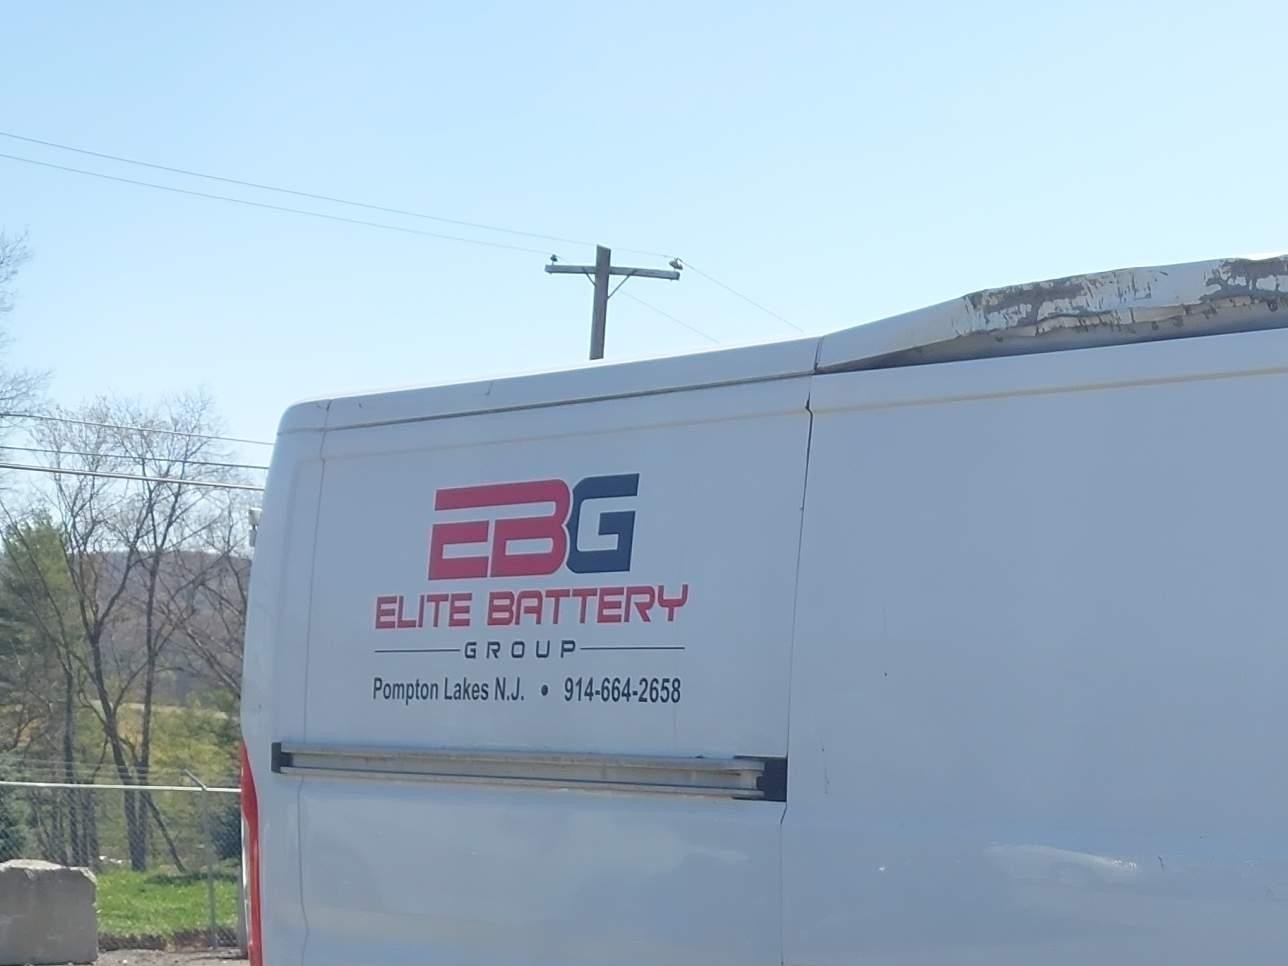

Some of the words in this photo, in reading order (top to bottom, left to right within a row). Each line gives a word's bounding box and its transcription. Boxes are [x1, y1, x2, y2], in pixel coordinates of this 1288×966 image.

[428, 473, 640, 580] EBG
[374, 592, 473, 629] ELITE
[487, 583, 689, 626] BATTERY
[464, 640, 576, 658] GROUP
[373, 677, 439, 705] Pompton
[444, 678, 489, 701] Lakes
[494, 677, 525, 701] N.J.
[564, 677, 681, 703] 914-664-2658
